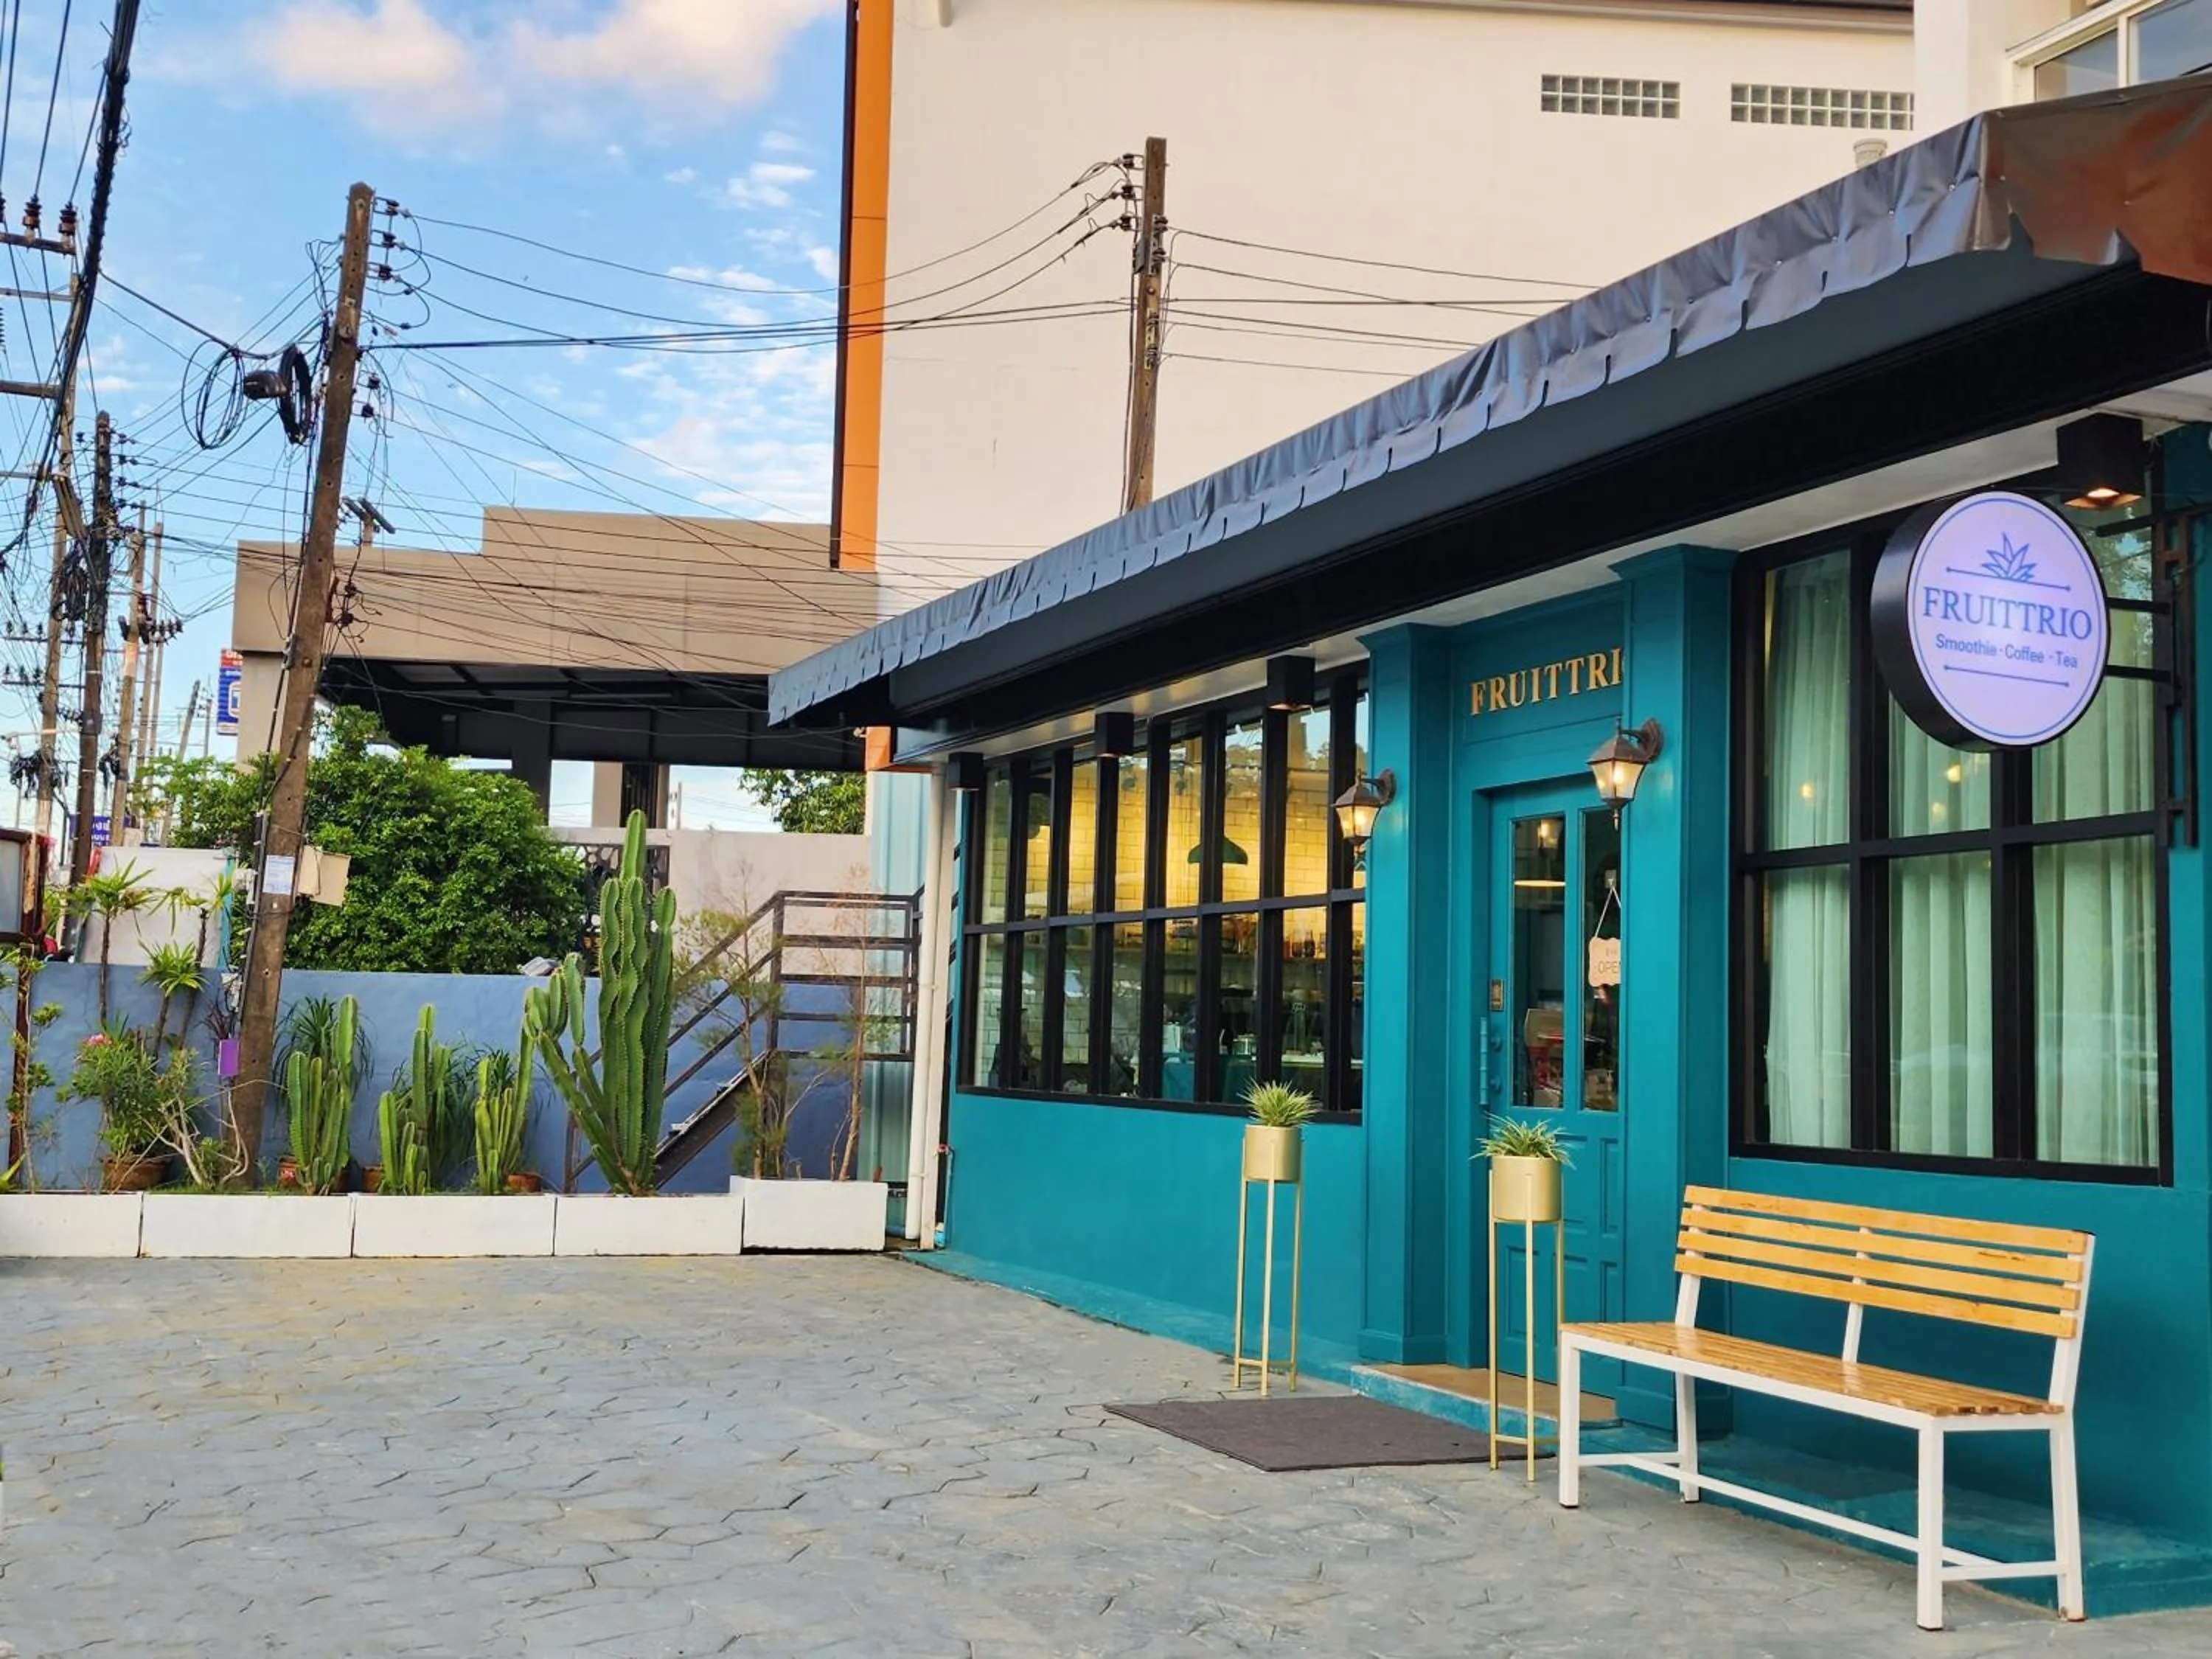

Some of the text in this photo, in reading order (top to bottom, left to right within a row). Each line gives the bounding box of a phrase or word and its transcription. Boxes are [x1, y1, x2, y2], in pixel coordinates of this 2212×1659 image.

[1922, 587, 2092, 639] FRUITTRIO
[1935, 633, 2078, 668] Smoothie Coffee Tea
[1470, 647, 1624, 715] FRUITTRI
[1598, 960, 1621, 974] OPE
